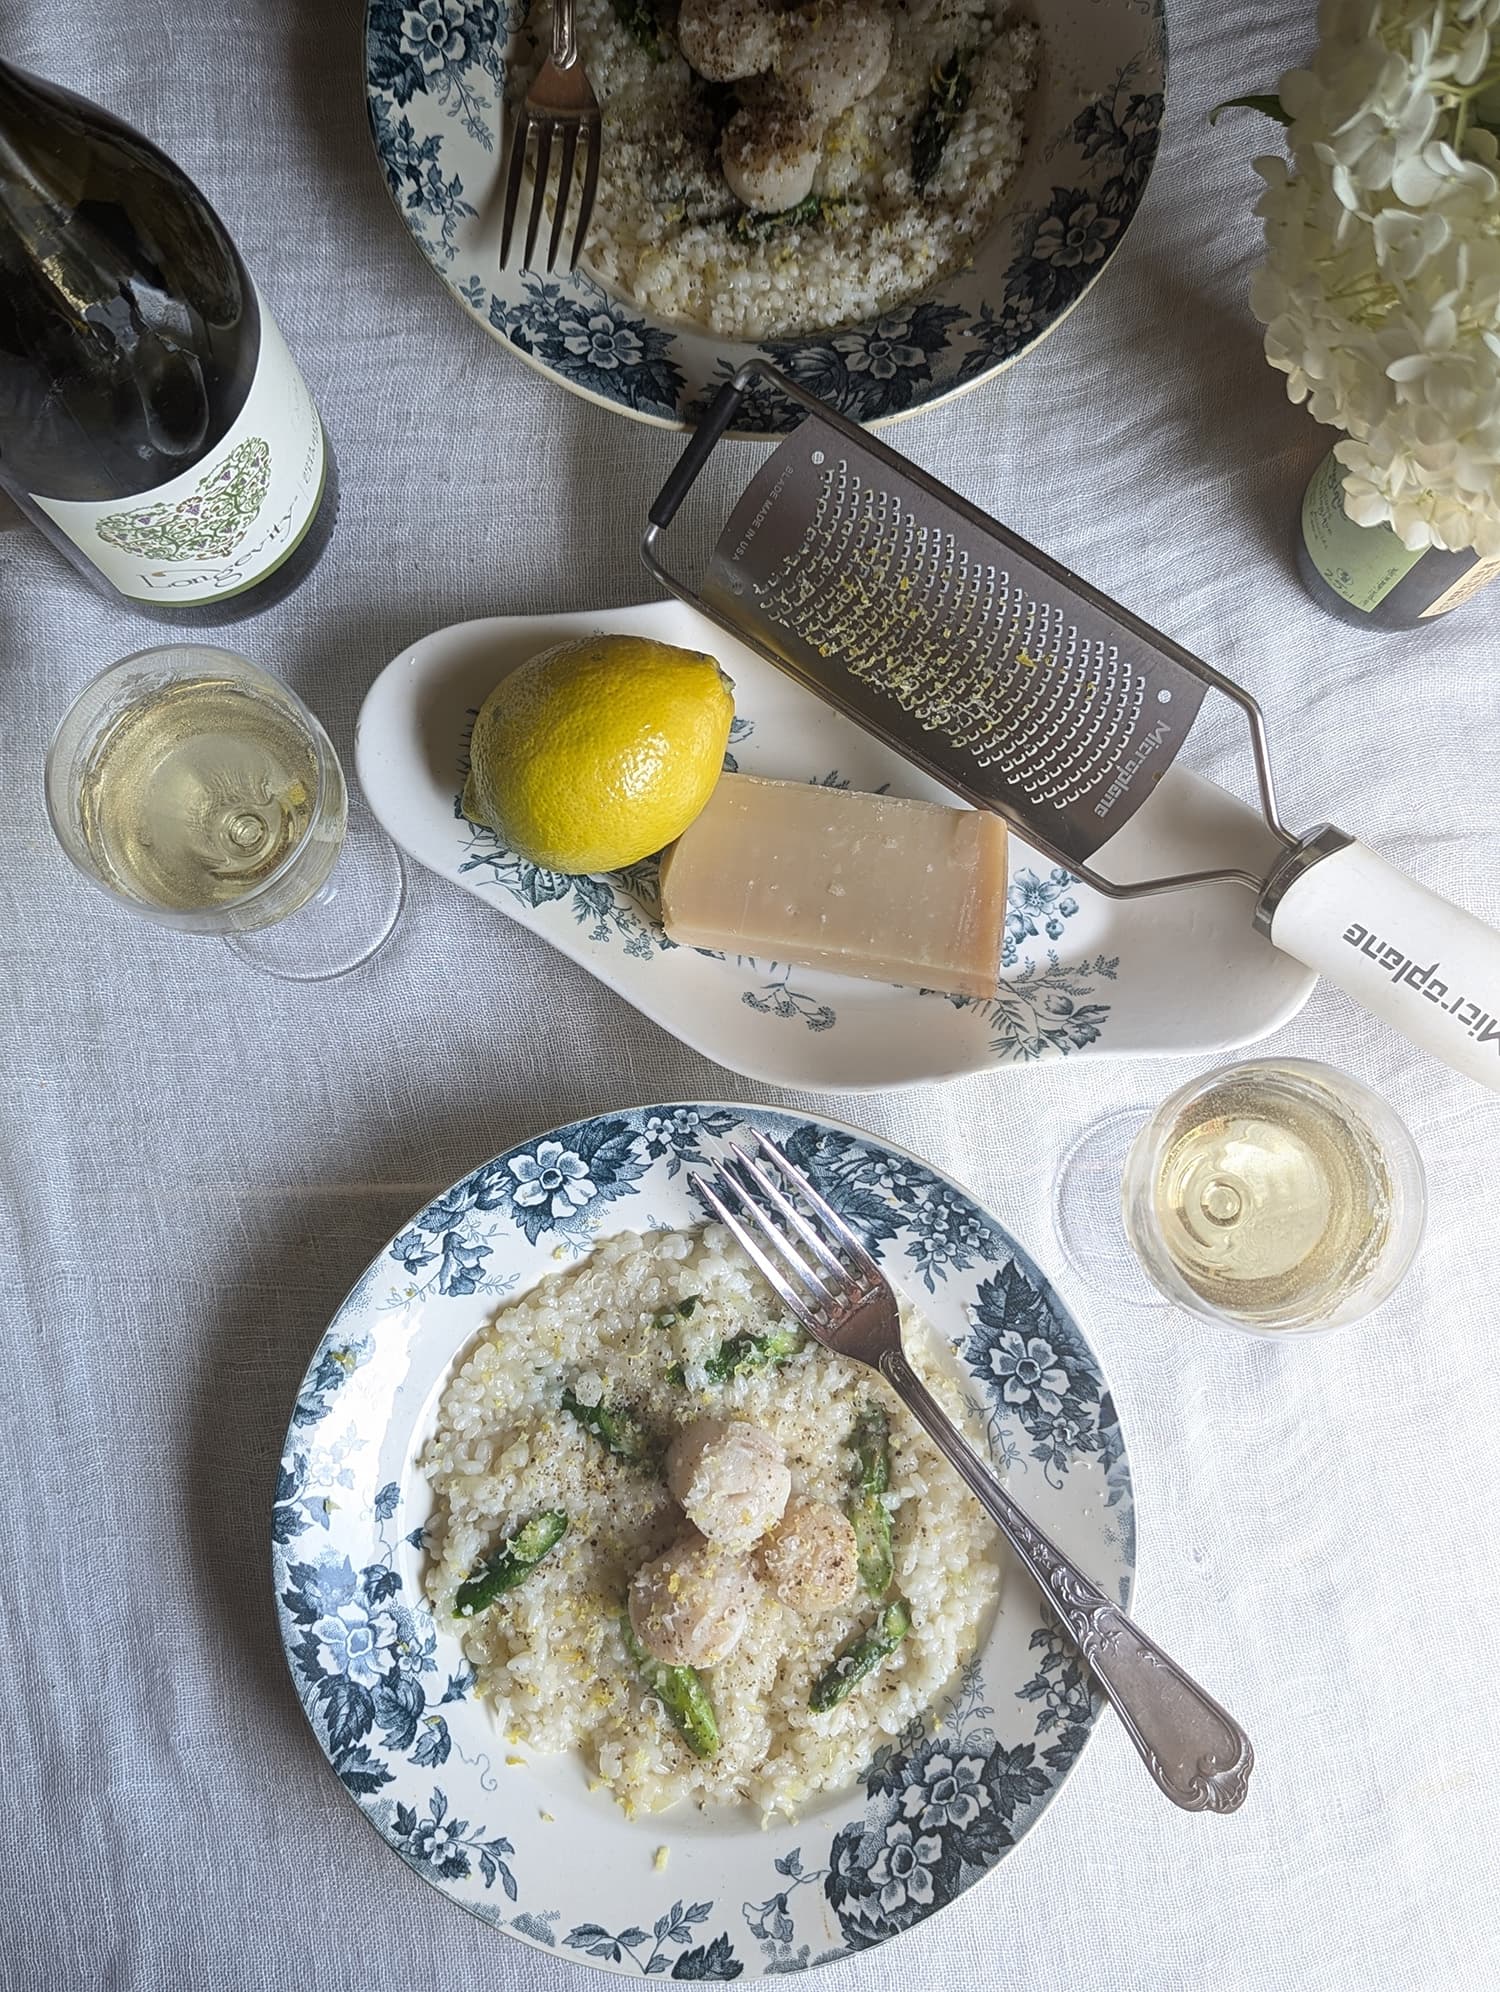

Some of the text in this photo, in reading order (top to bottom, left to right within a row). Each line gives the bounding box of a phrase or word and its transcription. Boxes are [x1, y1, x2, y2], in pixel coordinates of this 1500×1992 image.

[136, 495, 298, 589] Longevity
[731, 465, 794, 562] BLADE MADE IN USA
[1094, 719, 1172, 818] Microplane
